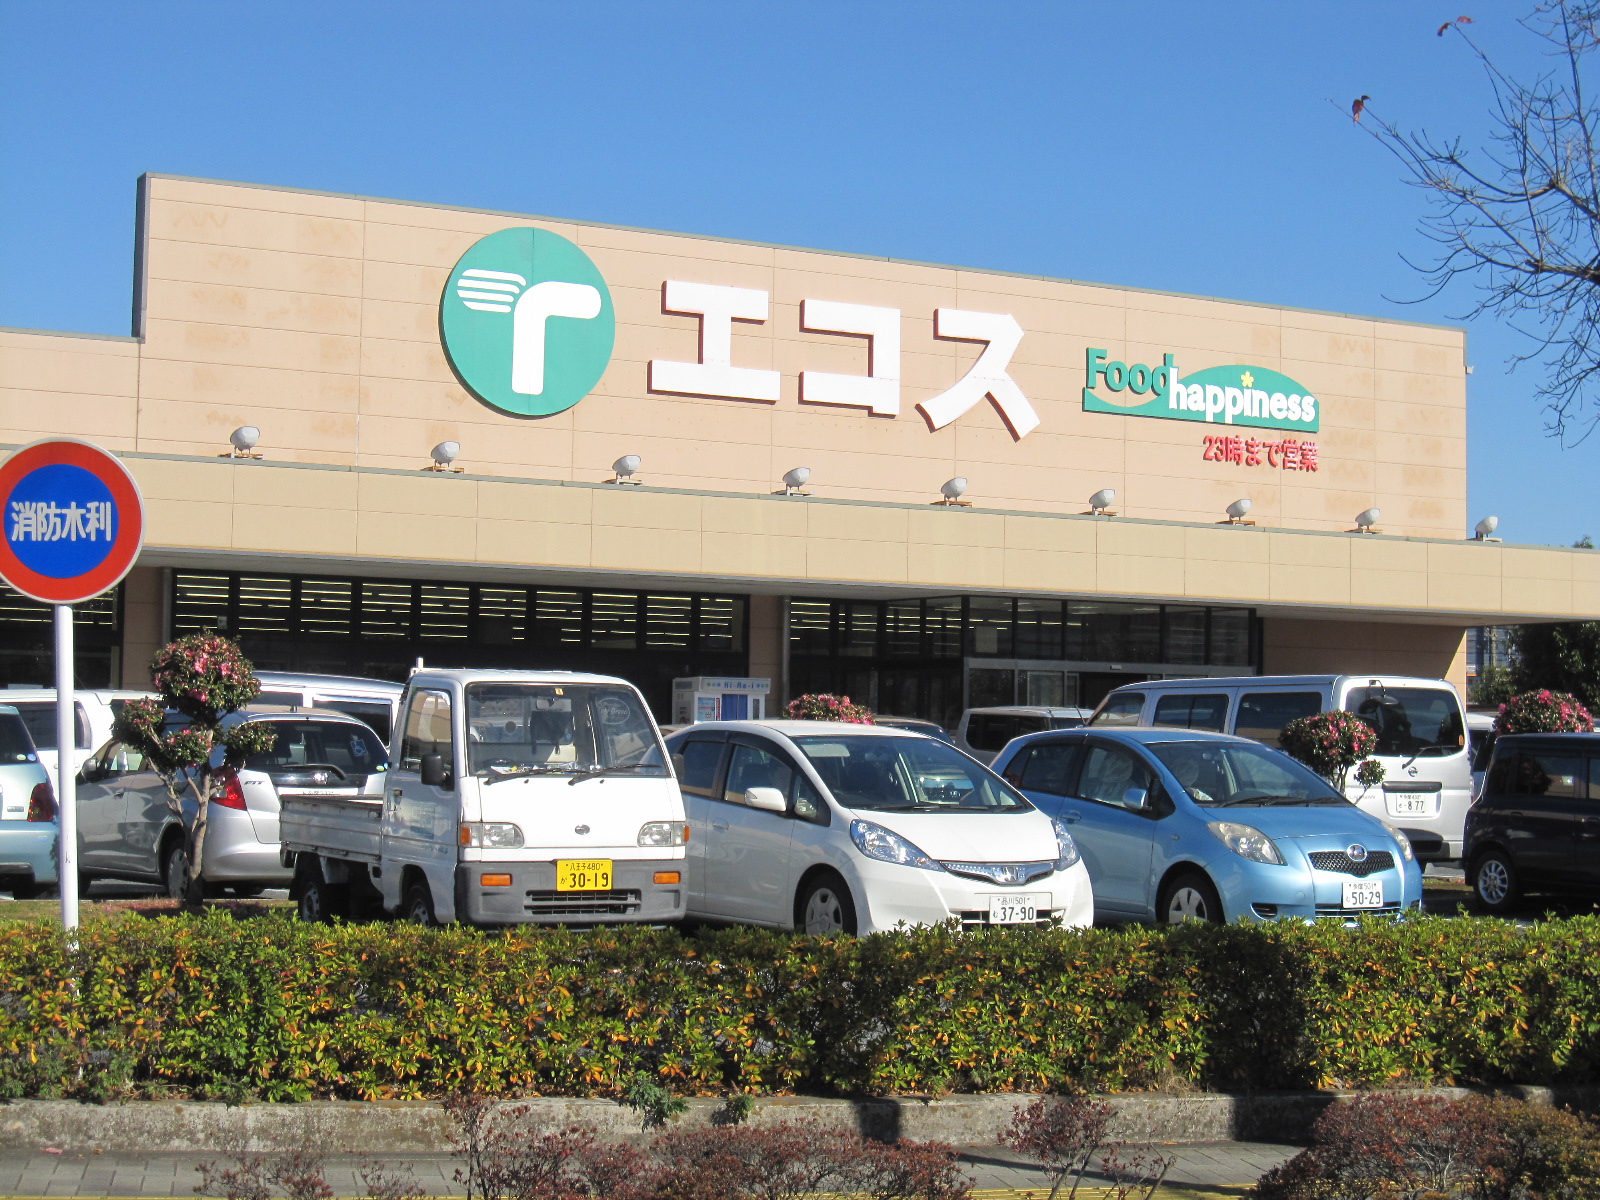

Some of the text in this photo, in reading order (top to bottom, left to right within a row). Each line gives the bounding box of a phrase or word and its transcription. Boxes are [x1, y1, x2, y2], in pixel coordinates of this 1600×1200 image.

[649, 280, 1041, 441] エコス
[1086, 347, 1175, 396] Food
[1169, 367, 1317, 424] happiness
[1203, 435, 1319, 472] 23時まで営業
[12, 501, 112, 541] 消防水利
[569, 872, 609, 888] 30-19
[570, 862, 601, 871] 八王子480
[1000, 906, 1035, 922] 37-90
[1001, 896, 1026, 906] 品川501
